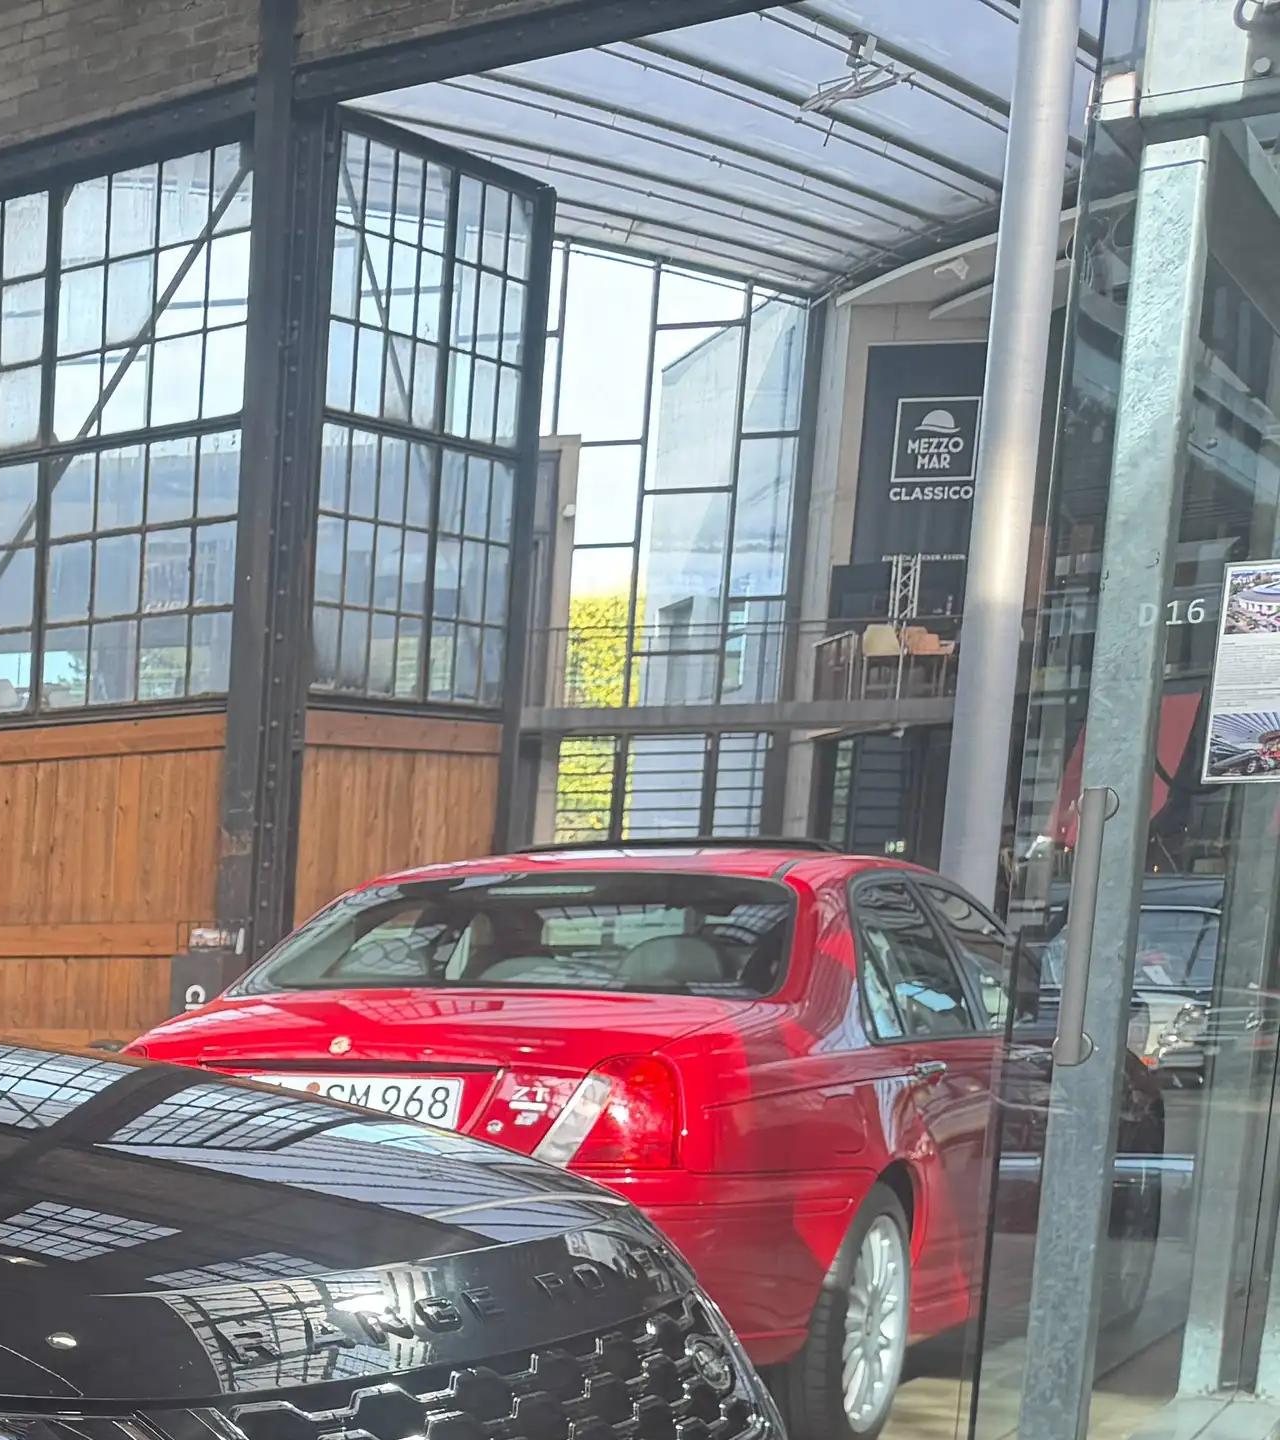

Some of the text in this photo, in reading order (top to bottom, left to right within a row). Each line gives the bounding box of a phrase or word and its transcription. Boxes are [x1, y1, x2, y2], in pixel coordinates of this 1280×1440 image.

[907, 437, 964, 454] MEZZO
[916, 453, 951, 469] MAR
[889, 485, 974, 501] CLASSICO
[1165, 598, 1205, 626] 16
[381, 1085, 450, 1119] 968
[512, 1085, 550, 1102] ZT
